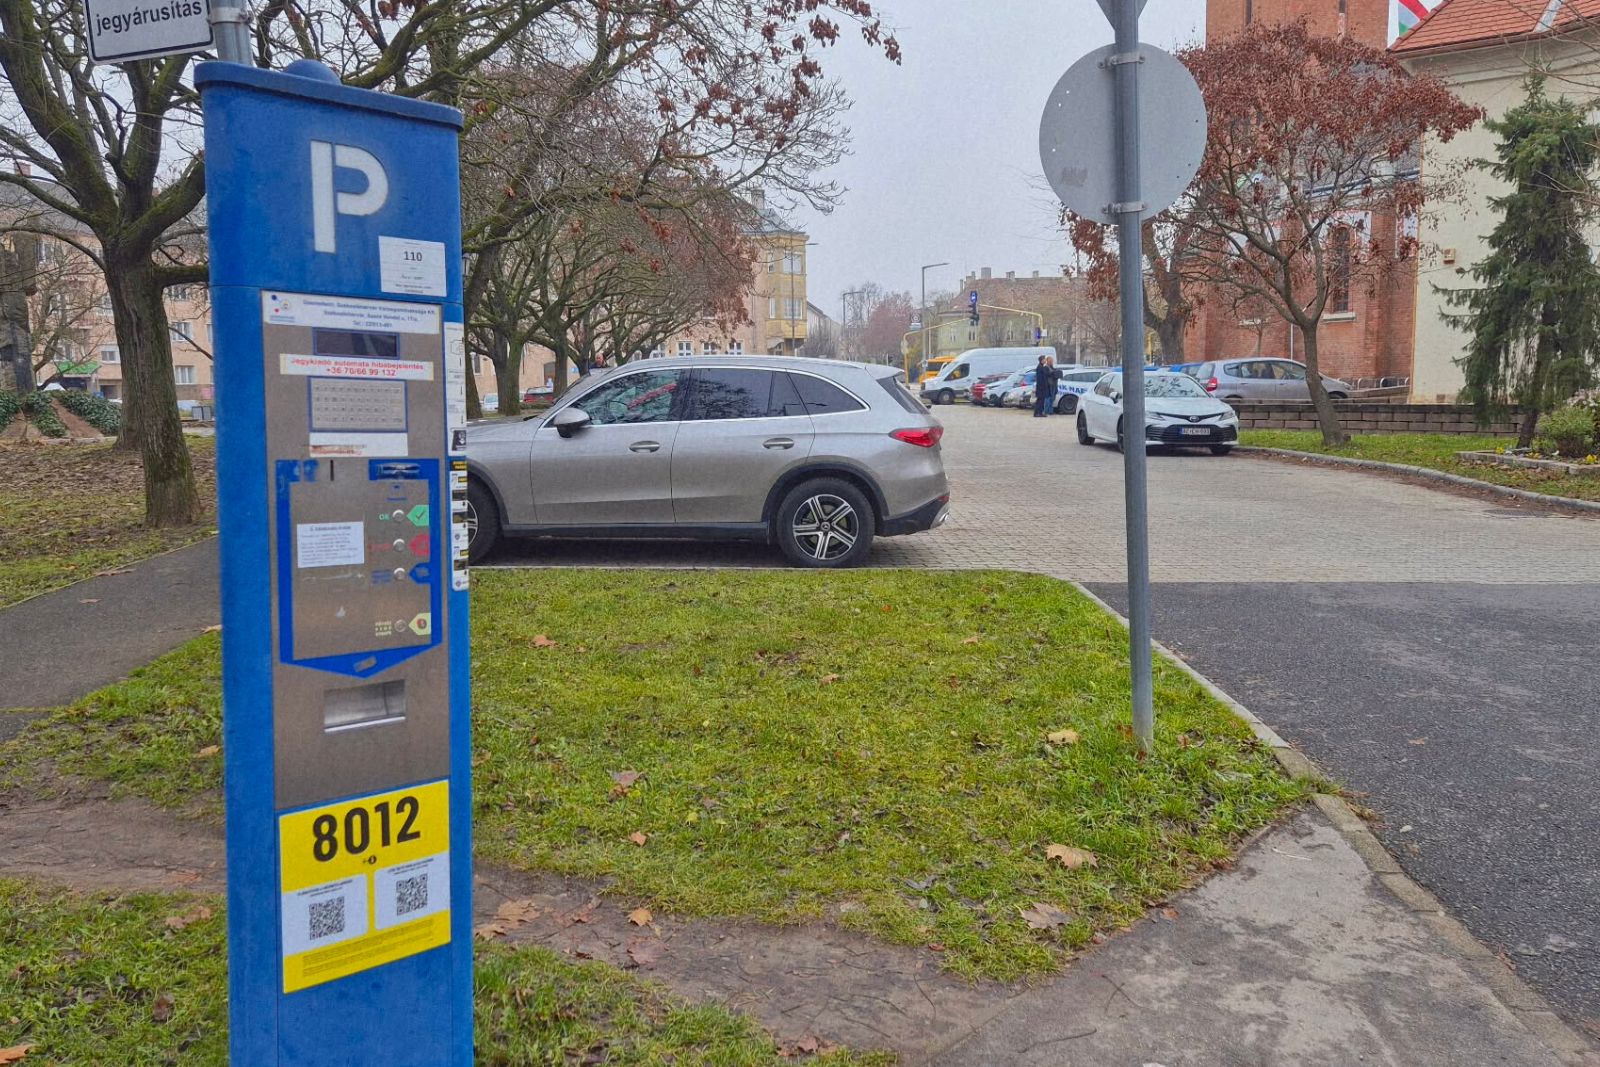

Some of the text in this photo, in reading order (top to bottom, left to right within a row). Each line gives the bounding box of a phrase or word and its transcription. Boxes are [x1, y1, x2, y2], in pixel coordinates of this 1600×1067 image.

[96, 0, 203, 37] jegyárusítás
[310, 139, 390, 254] P
[403, 251, 423, 262] 110
[313, 796, 421, 862] 8012
